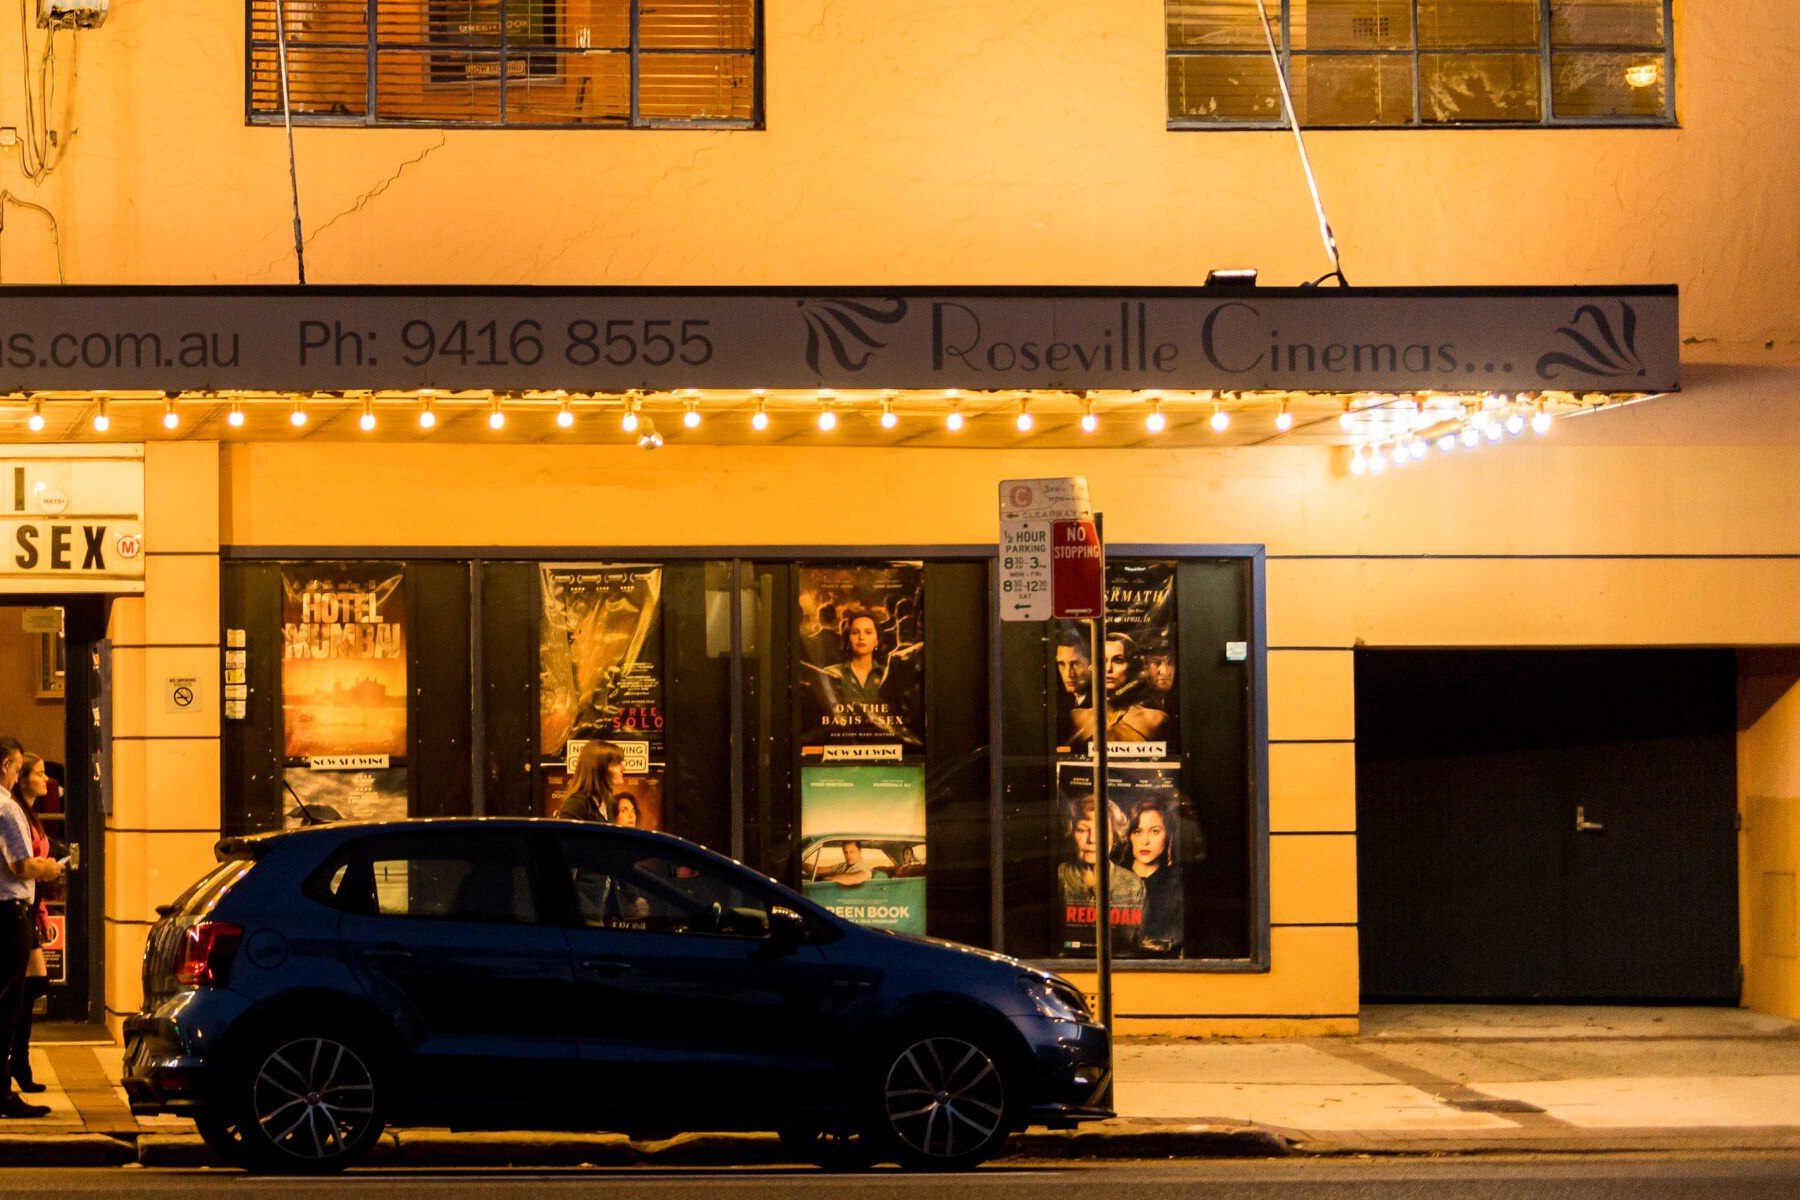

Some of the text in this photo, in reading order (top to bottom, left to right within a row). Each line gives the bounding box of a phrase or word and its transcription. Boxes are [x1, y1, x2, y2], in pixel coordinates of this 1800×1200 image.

[301, 318, 714, 367] Ph: 9416 8555
[931, 302, 1179, 373] Roseville
[1022, 510, 1078, 519] CLEARWAY
[1016, 531, 1046, 542] HOUR
[1067, 527, 1086, 542] NO
[15, 524, 107, 570] SEX
[121, 541, 135, 554] M
[1005, 544, 1046, 553] PARKING
[1055, 546, 1099, 559] STOPPING
[302, 592, 384, 623] HOTEL
[284, 622, 401, 659] MUMBAI
[618, 707, 657, 717] FREE
[836, 703, 889, 713] ON THE
[612, 717, 664, 729] SOLO
[822, 716, 862, 725] BASIS
[878, 716, 904, 725] SEX
[853, 748, 897, 756] SHOWING
[313, 757, 383, 766] NOW SHOWING
[867, 906, 910, 919] BOOK
[1066, 906, 1097, 924] RED
[1110, 908, 1142, 926] OAN
